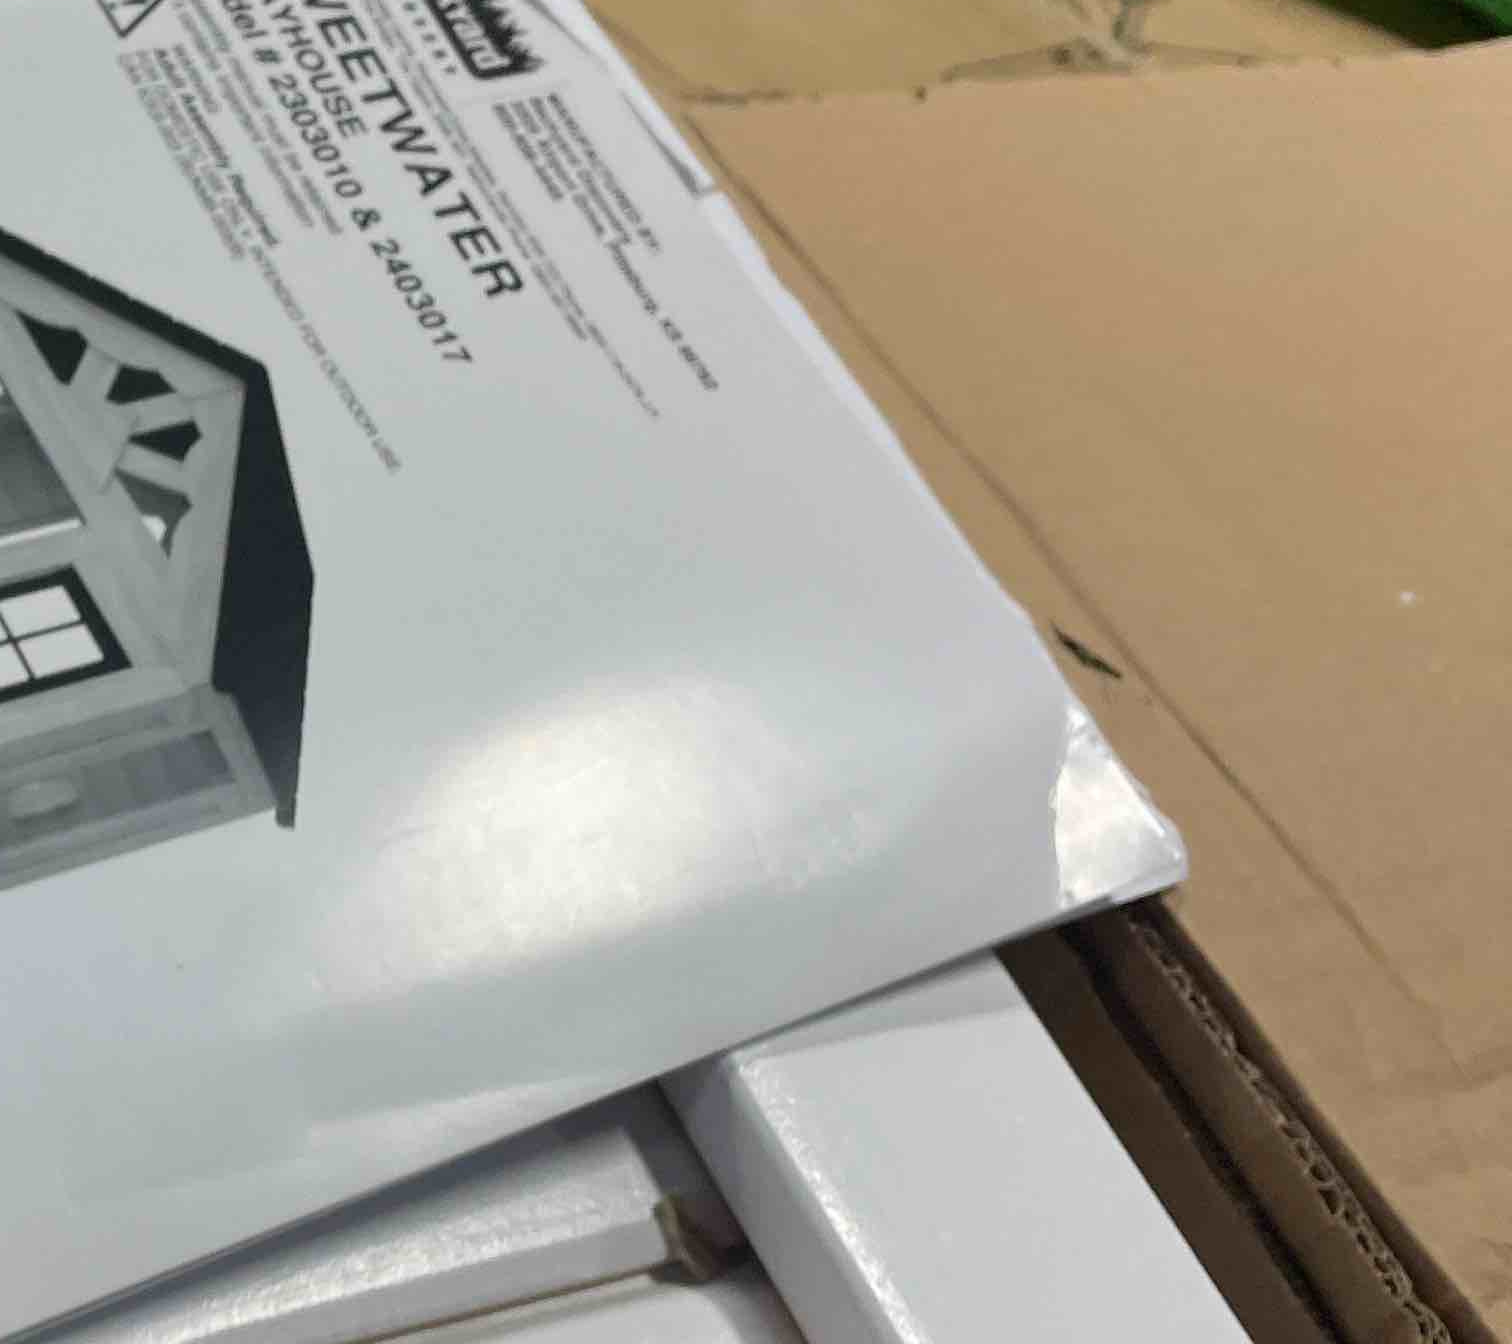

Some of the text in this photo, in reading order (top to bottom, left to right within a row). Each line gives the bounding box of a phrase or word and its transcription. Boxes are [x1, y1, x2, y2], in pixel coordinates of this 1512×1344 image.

[268, 74, 363, 200] 2303010
[351, 206, 381, 232] &
[369, 239, 473, 364] 2403017
